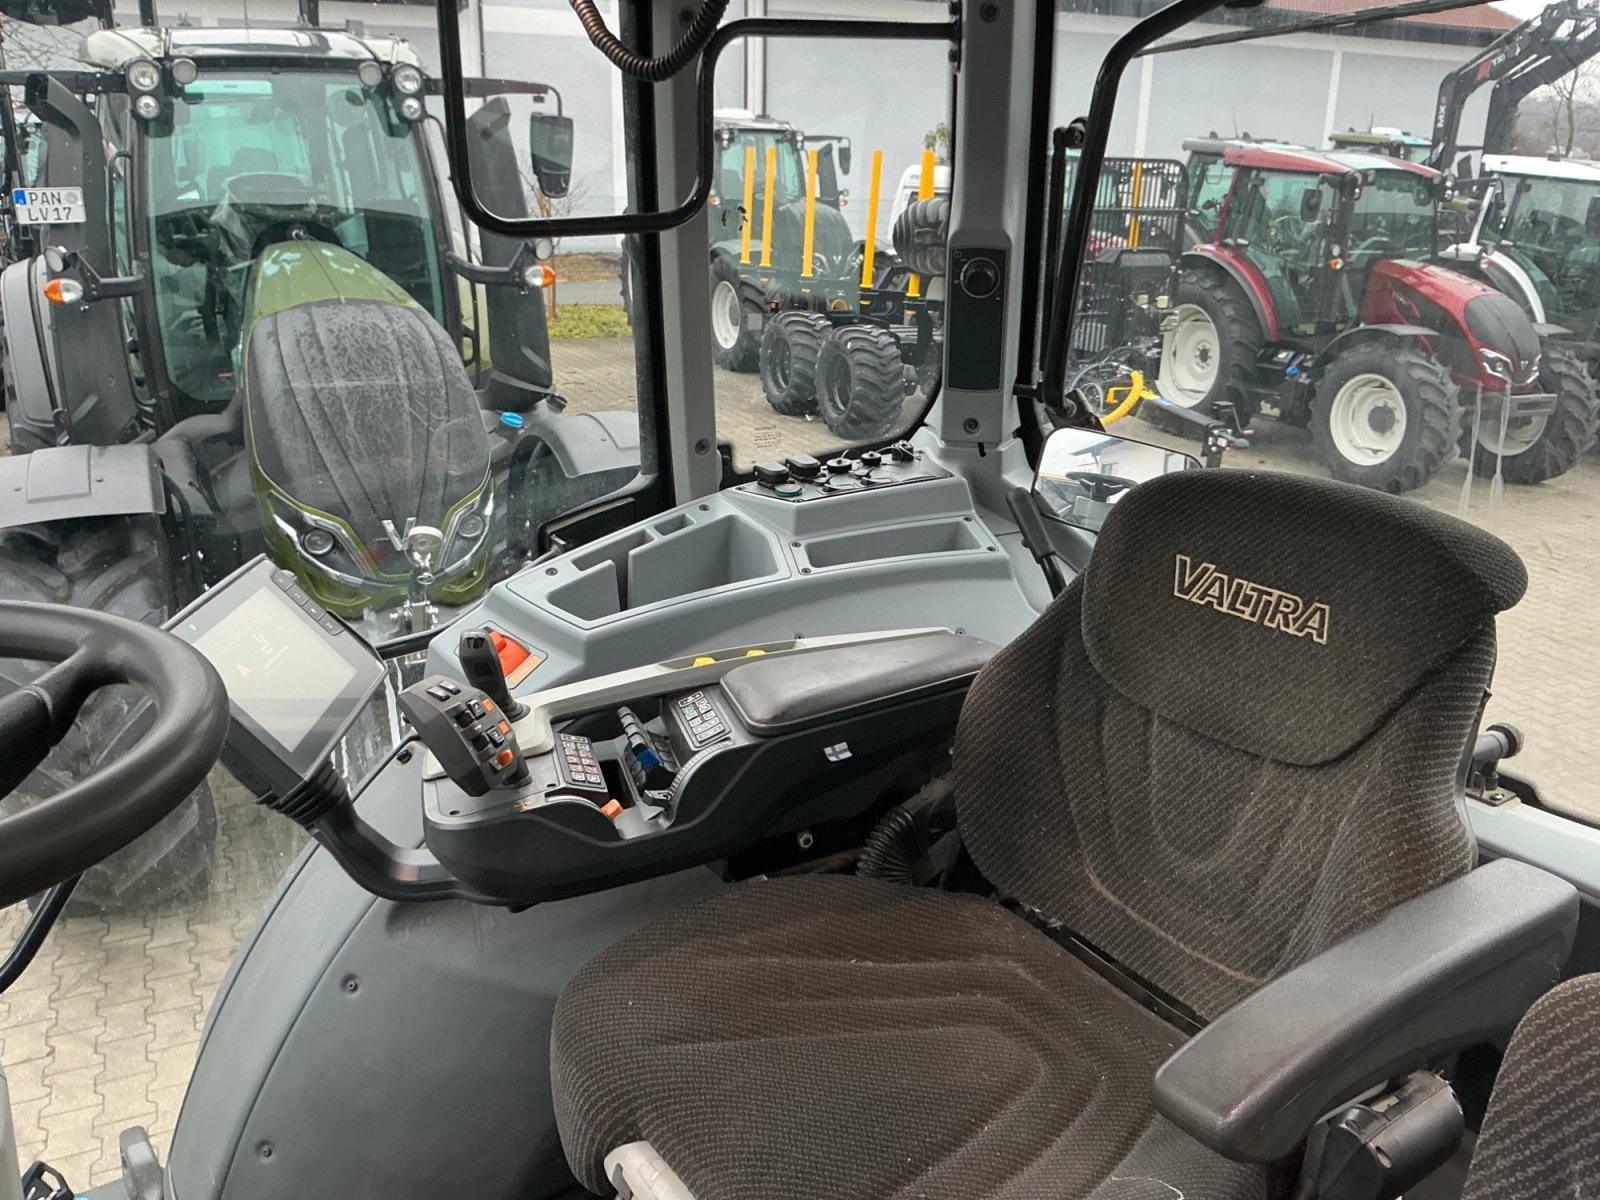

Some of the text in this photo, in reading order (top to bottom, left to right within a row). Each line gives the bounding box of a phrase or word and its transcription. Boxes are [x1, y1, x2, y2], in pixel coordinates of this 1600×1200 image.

[28, 191, 62, 206] PAN
[28, 206, 72, 222] LV 17
[1173, 553, 1330, 645] VALTRA
